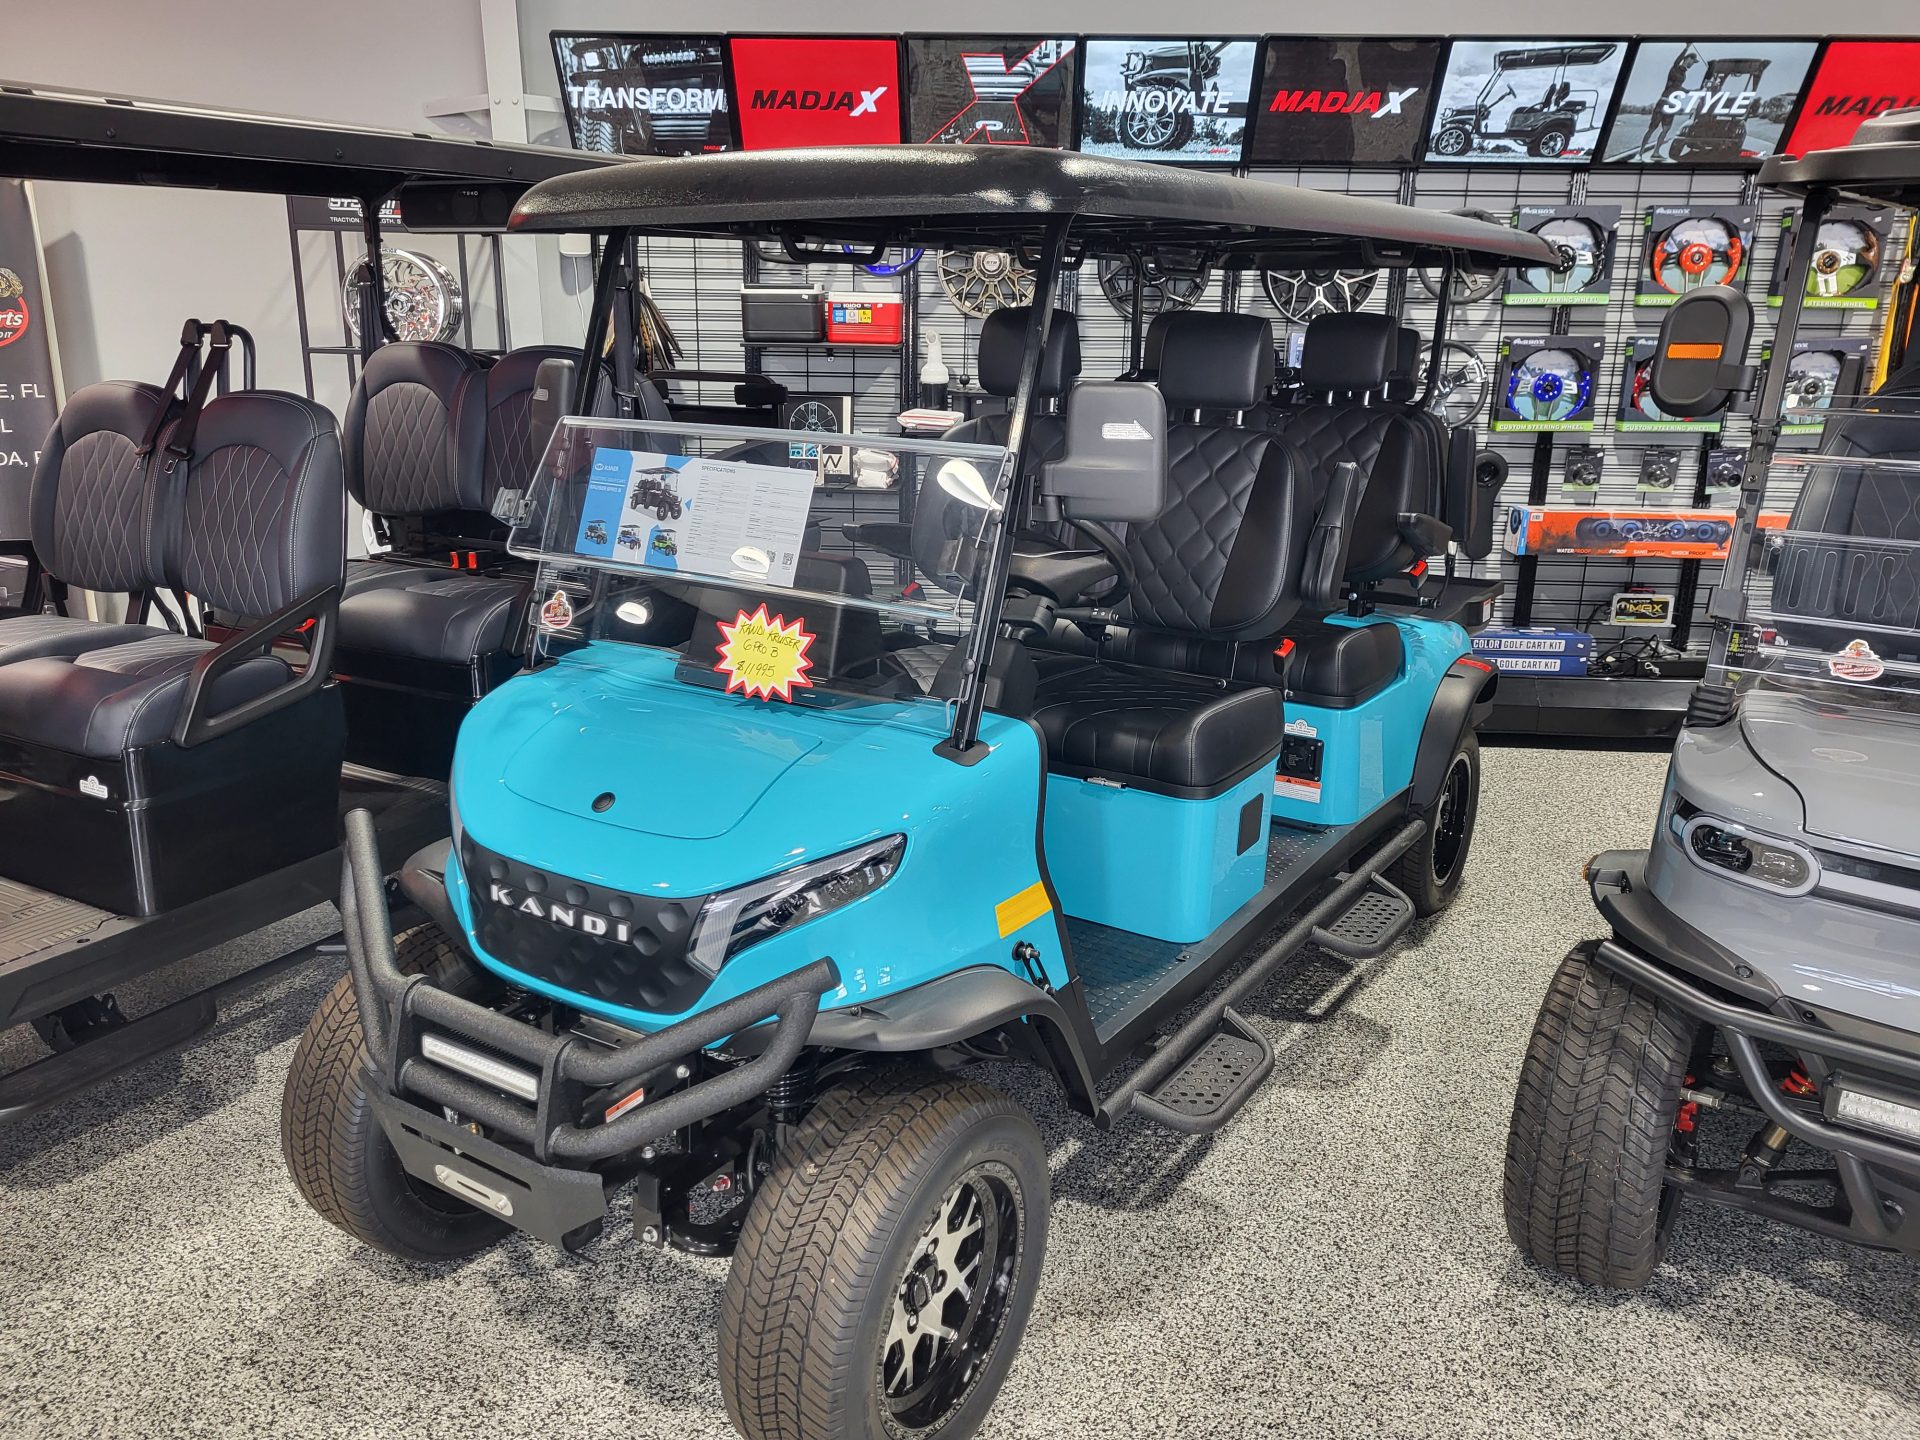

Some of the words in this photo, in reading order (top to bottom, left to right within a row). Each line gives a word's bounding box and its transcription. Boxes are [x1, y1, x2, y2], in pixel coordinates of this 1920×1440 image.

[567, 87, 725, 110] TRANSFORM
[751, 87, 887, 117] MADJAX
[1101, 90, 1233, 114] INNOVATE
[1269, 88, 1418, 118] MADJAX
[1662, 91, 1756, 115] STYLE
[0, 312, 24, 326] rts
[20, 383, 46, 398] FL
[0, 418, 13, 433] L
[1473, 639, 1500, 649] COLOR
[1503, 640, 1524, 649] GOLF
[1526, 640, 1546, 650] CART
[1549, 641, 1565, 650] KIT
[735, 660, 776, 678] $11995
[1499, 660, 1519, 668] GOLF
[1521, 660, 1541, 669] CART
[1544, 660, 1558, 669] KIT
[490, 883, 629, 942] KANDI
